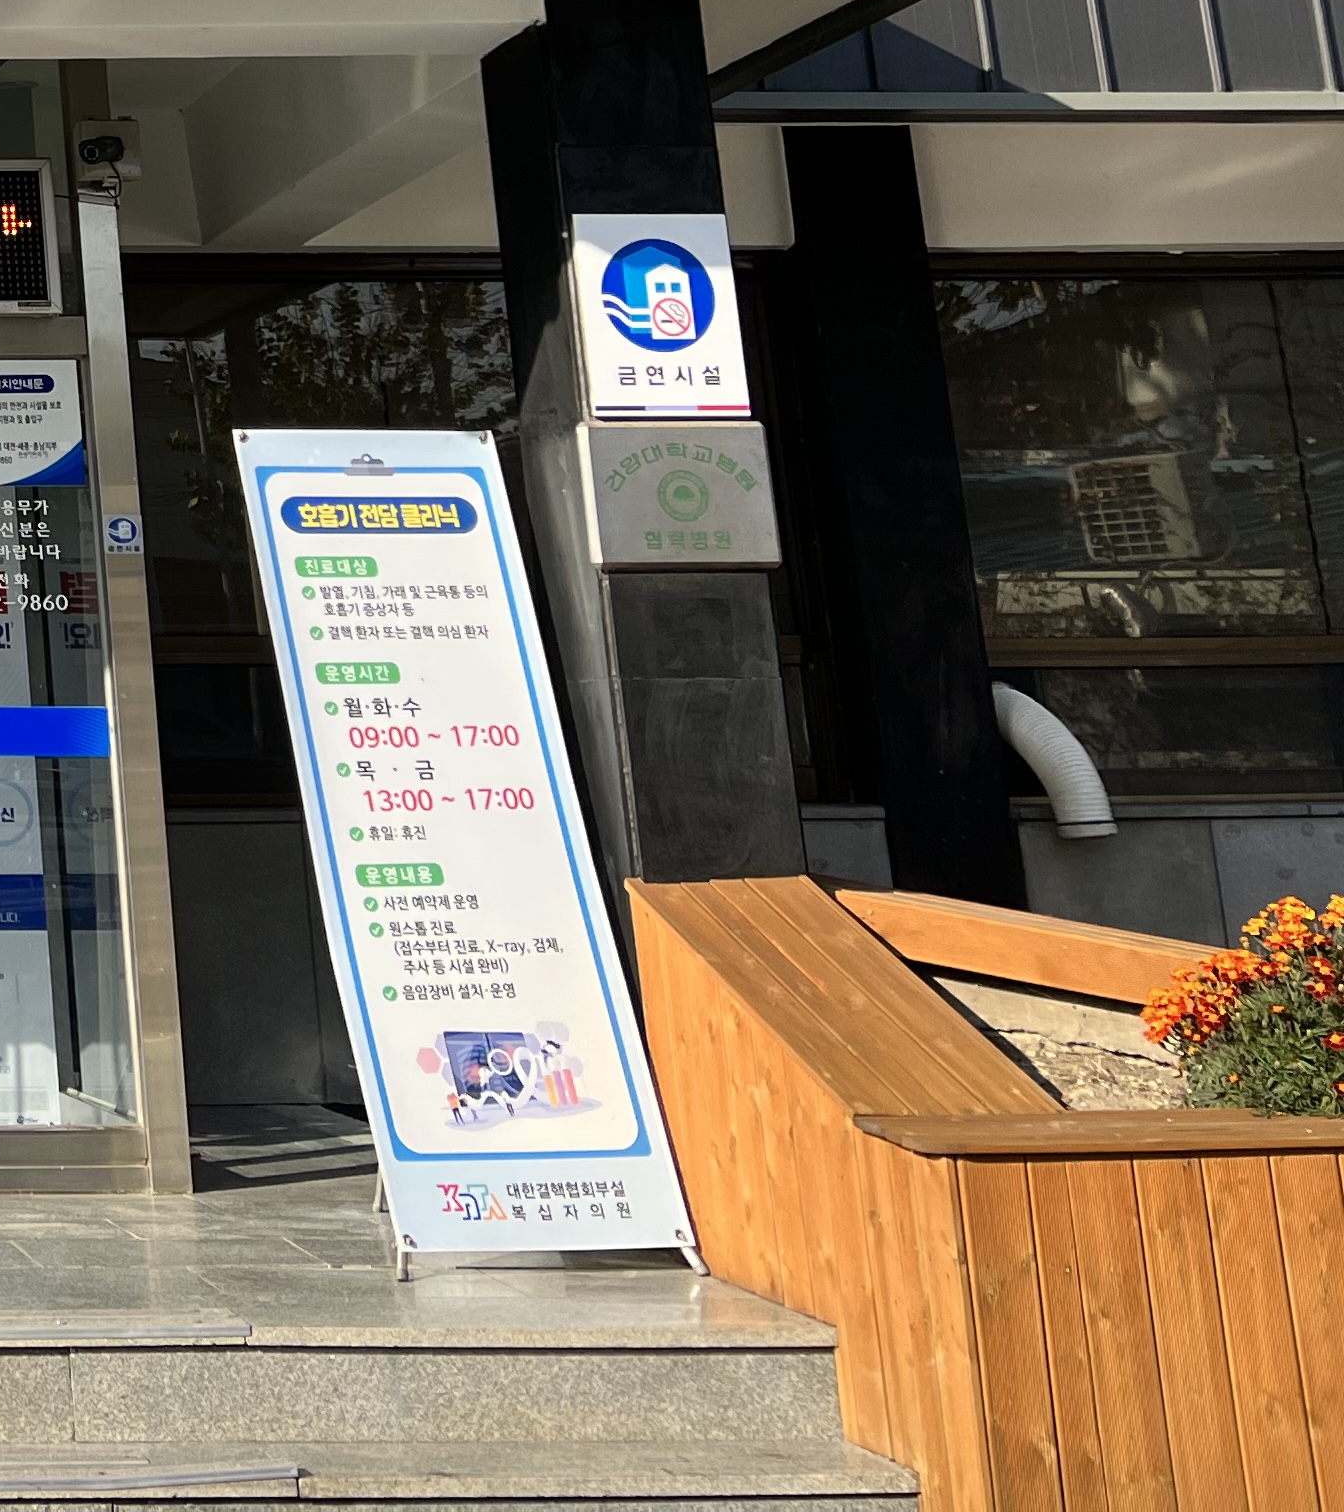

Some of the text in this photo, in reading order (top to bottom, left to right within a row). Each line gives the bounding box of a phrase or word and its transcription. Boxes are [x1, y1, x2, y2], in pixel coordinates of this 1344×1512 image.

[617, 364, 722, 387] 금연시설
[604, 441, 758, 493] 건양대학교병원
[1, 500, 49, 516] 용무가
[298, 503, 460, 528] 호흡기 전담 클리닉
[304, 559, 367, 576] 진료대상
[383, 585, 407, 600] 가래
[410, 585, 421, 600] 및
[424, 585, 460, 600] 근육통
[463, 585, 489, 600] 등의
[324, 603, 414, 617] 호흡기 증상자 등
[328, 626, 489, 640] 결핵 환자 또는 결핵 의심 환자
[325, 665, 390, 682] 운영시간
[343, 697, 422, 718] 월·화·수
[349, 725, 519, 748] 09:00 17:00
[363, 788, 534, 812] 13:00 17:00
[369, 825, 427, 841] 휴일: 휴진
[364, 866, 433, 885] 운영내용
[384, 894, 480, 911] 사전 예약제 운영
[389, 921, 457, 936] 원스톱 진료
[394, 940, 452, 956] (접수부터
[453, 940, 485, 954] 진료,
[404, 957, 510, 975] 주사 등 시설 완비)
[458, 983, 517, 999] 설치·운영
[506, 1180, 627, 1199] 대한결핵협회부설
